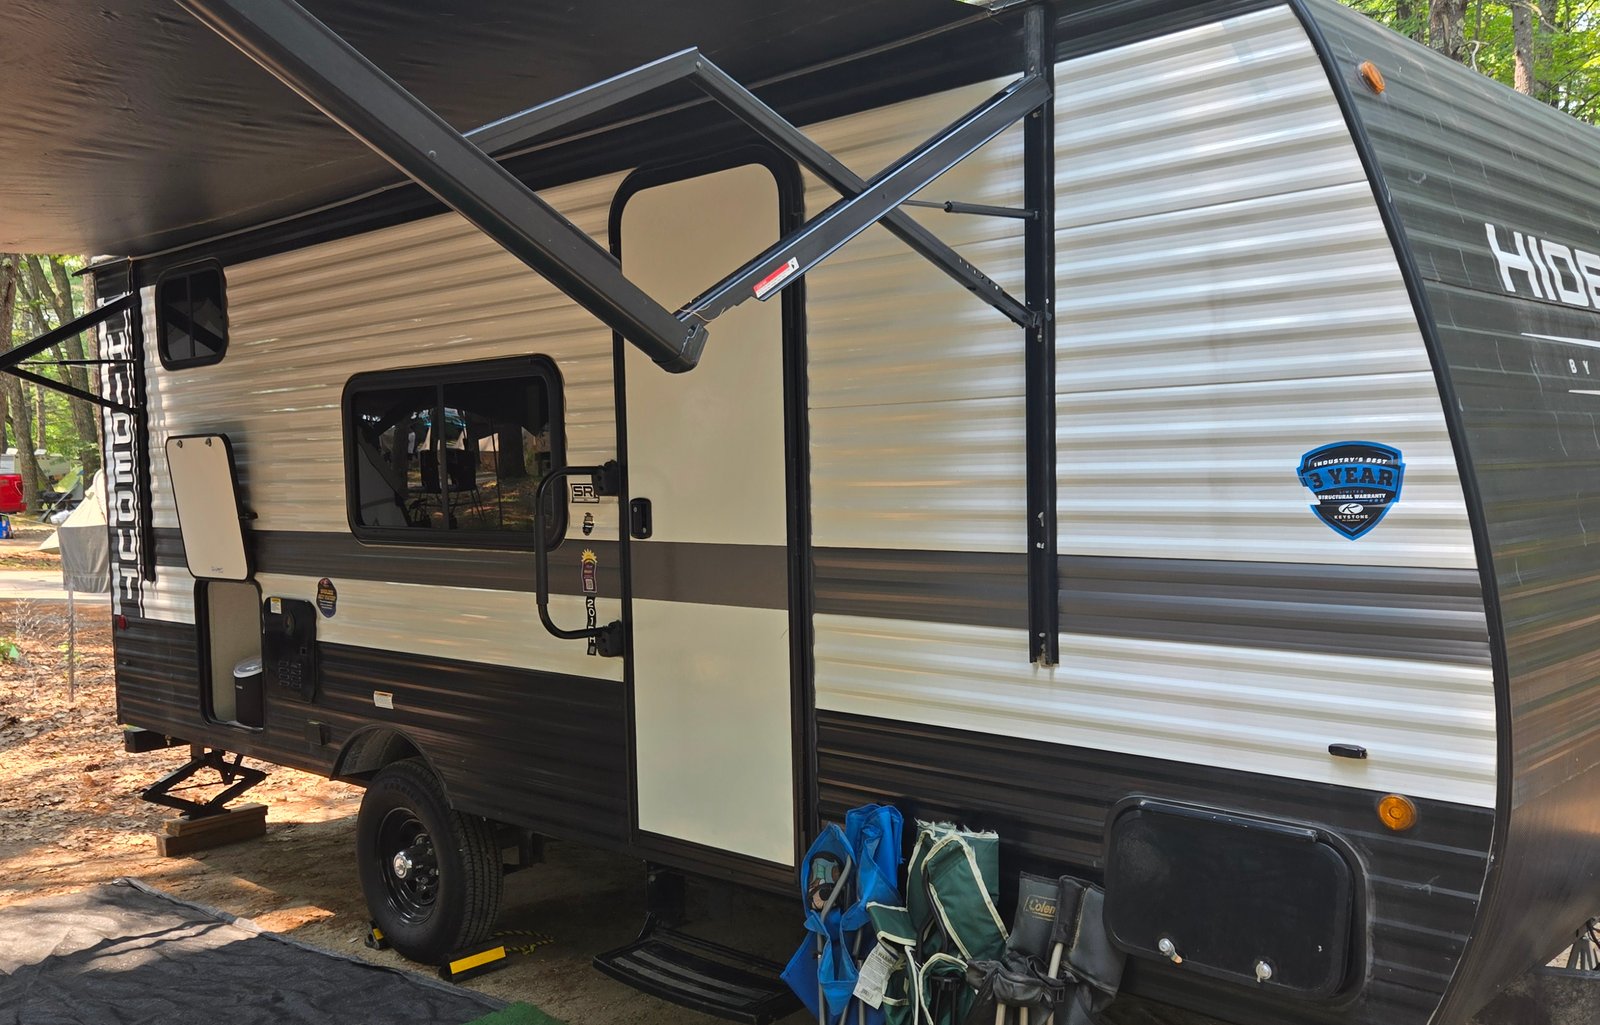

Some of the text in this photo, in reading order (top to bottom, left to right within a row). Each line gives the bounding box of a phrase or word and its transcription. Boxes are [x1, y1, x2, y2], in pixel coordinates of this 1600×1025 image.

[1568, 358, 1591, 374] BY
[107, 332, 136, 599] HIDEOUT
[1313, 457, 1388, 467] INDUSTRY'S BEST
[1309, 467, 1393, 488] 3 YEAR
[1029, 899, 1057, 914] Cole
